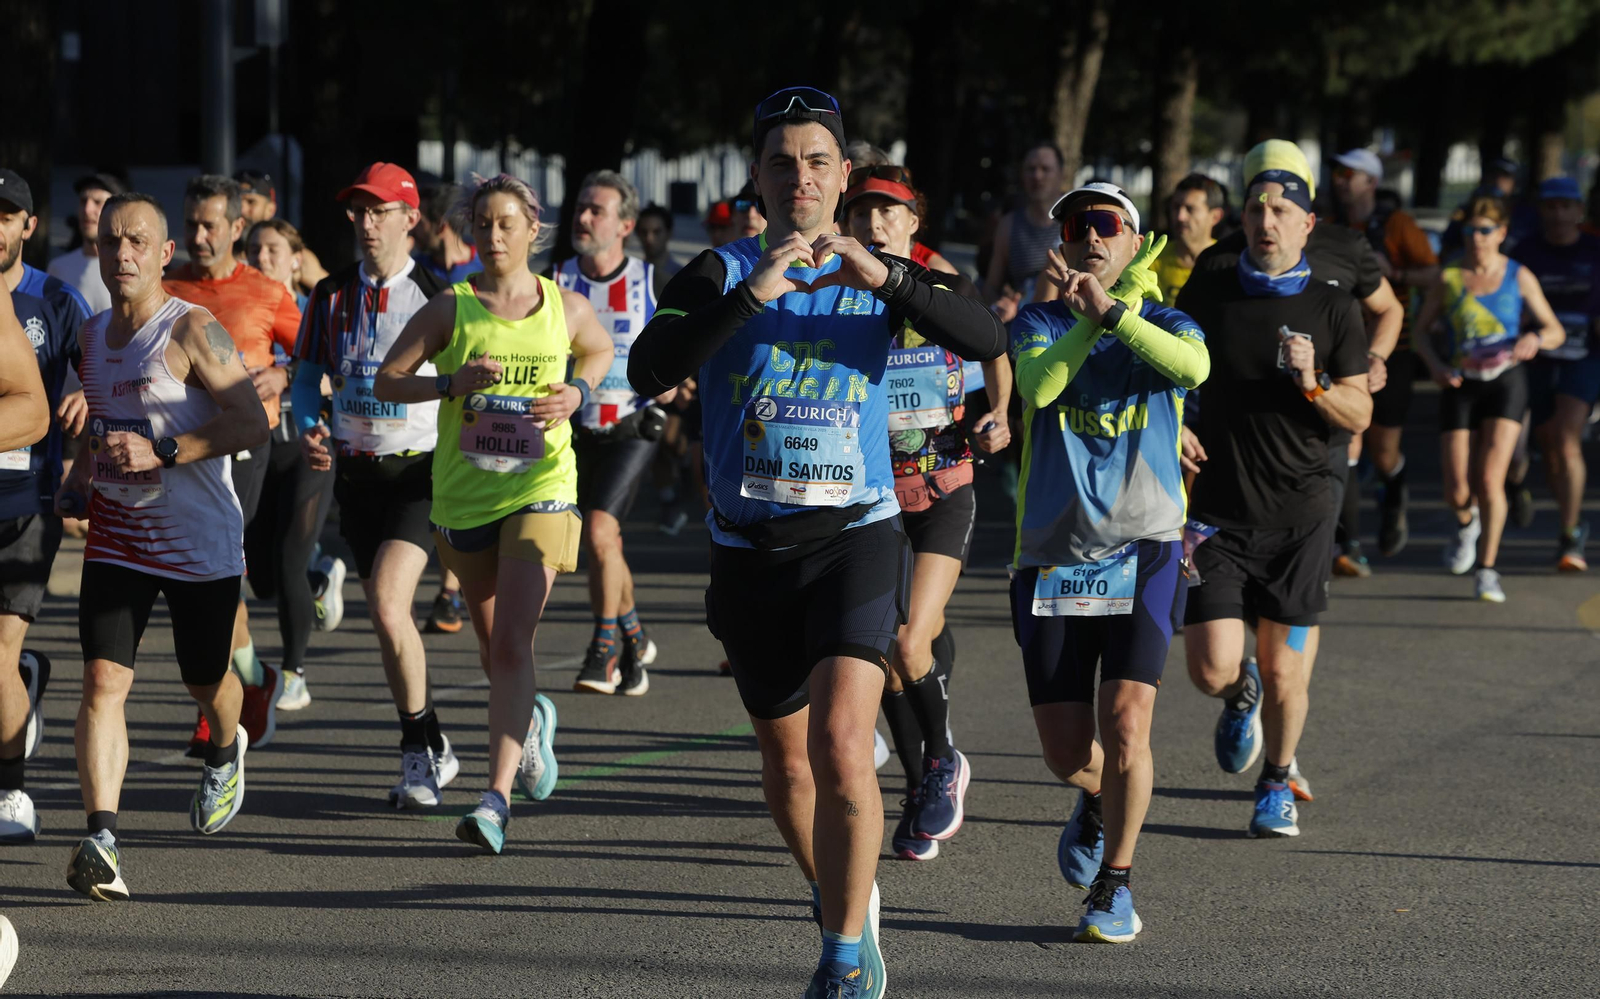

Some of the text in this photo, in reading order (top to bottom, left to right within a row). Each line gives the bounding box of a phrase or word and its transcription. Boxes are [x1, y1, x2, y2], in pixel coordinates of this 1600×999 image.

[469, 351, 558, 363] Hens Hospices
[769, 338, 836, 373] CDC
[886, 351, 935, 367] ZURICH
[355, 364, 378, 376] ZUR
[492, 366, 539, 386] LLIE
[355, 386, 374, 397] 662
[888, 377, 916, 390] 7602
[340, 398, 400, 417] LAURENT
[784, 405, 848, 422] ZURICH
[491, 422, 517, 434] 9985
[1056, 402, 1149, 438] TUSSAM
[475, 435, 530, 455] HOLLIE
[784, 436, 818, 452] 6649
[744, 455, 854, 481] DANI SANTOS
[1060, 579, 1109, 596] BUYO
